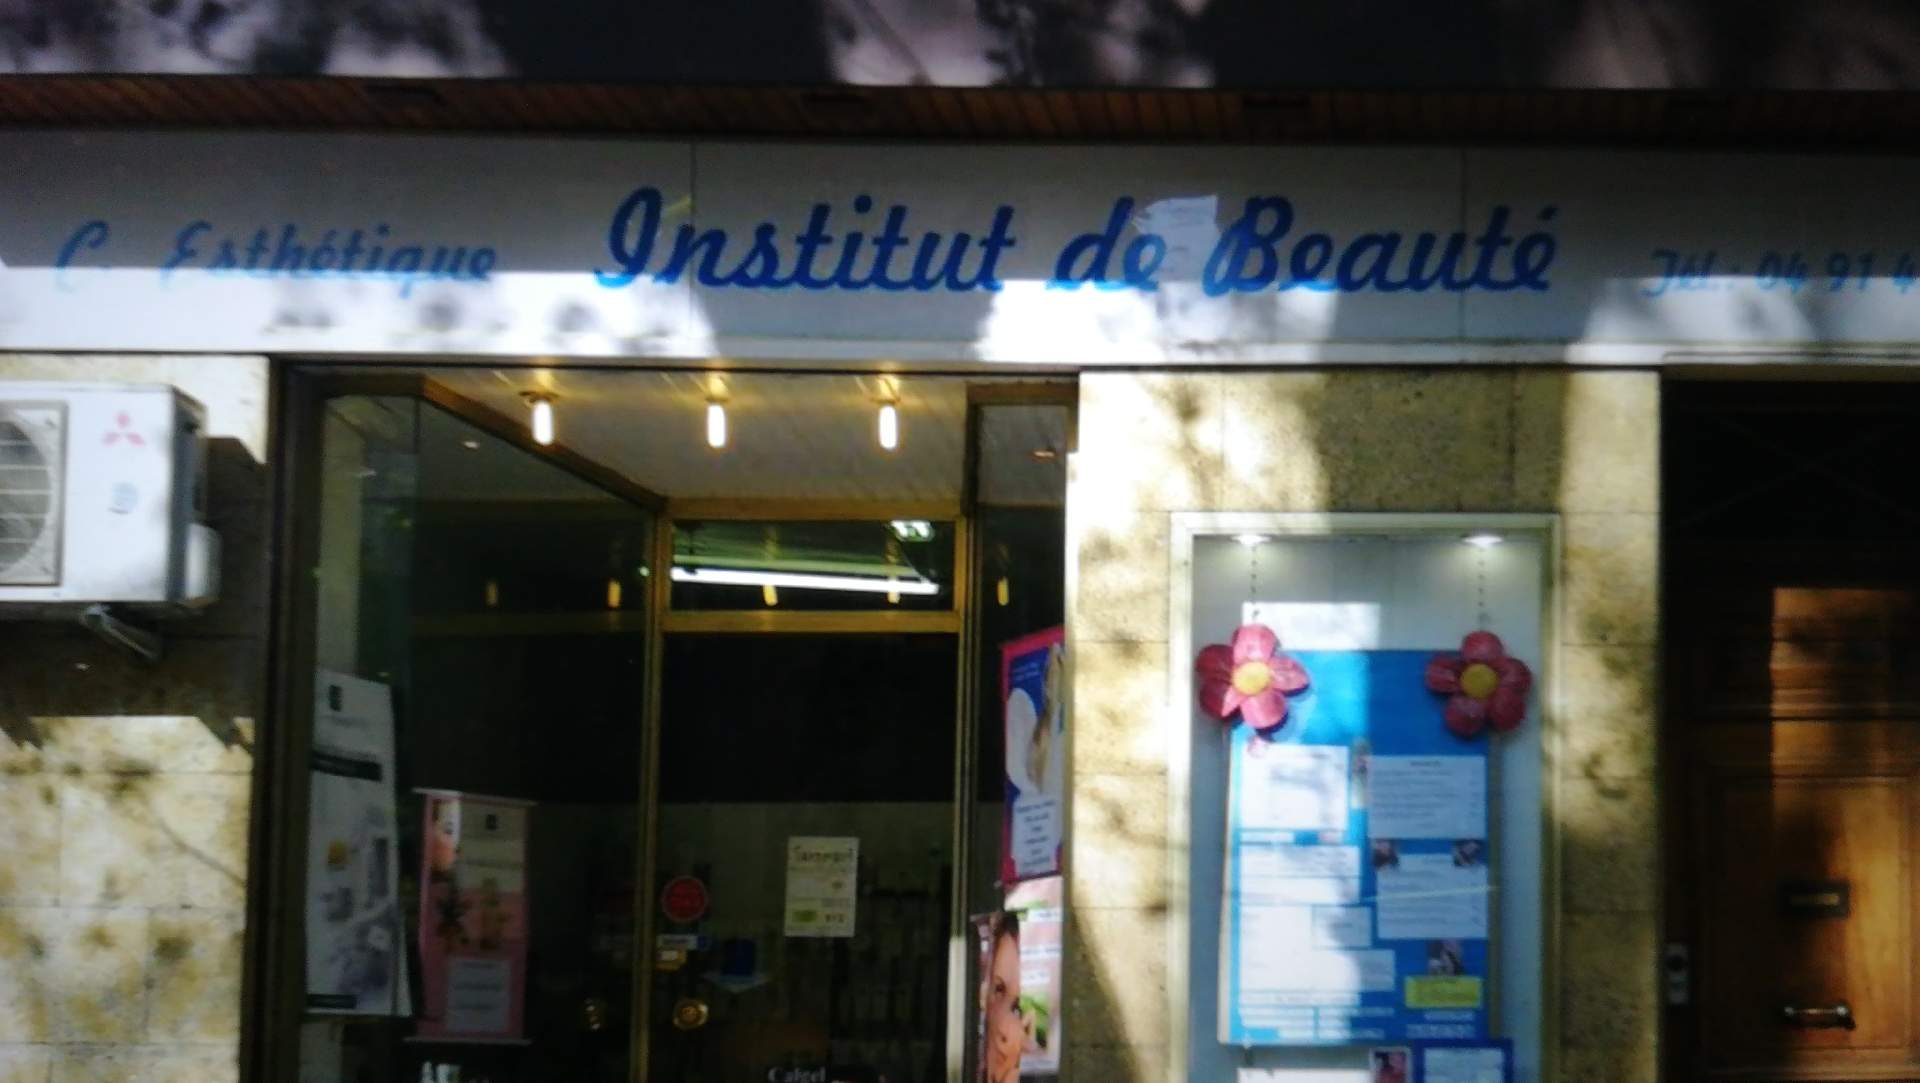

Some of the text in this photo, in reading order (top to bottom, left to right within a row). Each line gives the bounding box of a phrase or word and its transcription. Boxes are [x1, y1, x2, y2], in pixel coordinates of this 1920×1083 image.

[158, 220, 498, 298] Esthétique
[594, 187, 1559, 297] Institut de Beauté
[1754, 250, 1808, 293] 04
[1825, 251, 1874, 293] 91
